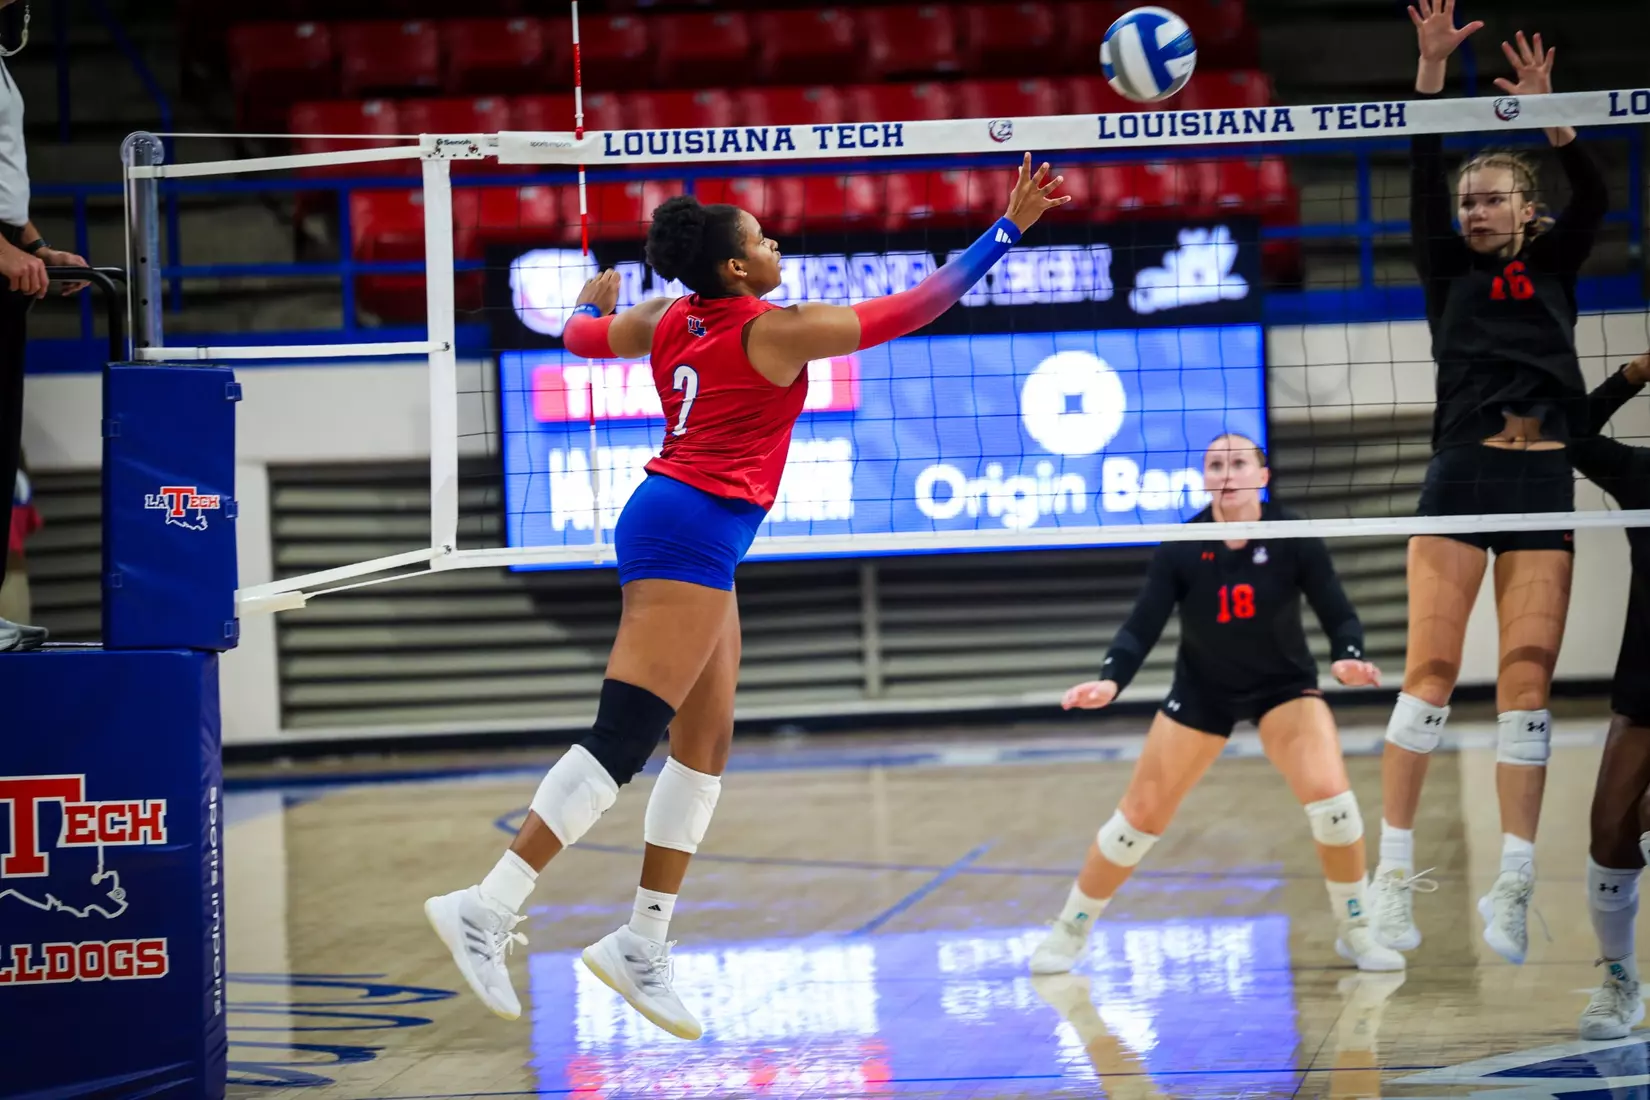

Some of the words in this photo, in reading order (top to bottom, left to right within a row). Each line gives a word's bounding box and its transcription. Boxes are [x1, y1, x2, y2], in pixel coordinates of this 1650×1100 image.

[604, 127, 795, 156] LOUISIANA
[812, 123, 904, 149] TECH
[1098, 108, 1294, 139] LOUISIANA
[1312, 103, 1406, 131] TECH
[1489, 261, 1535, 300] 16
[160, 486, 221, 517] TECH
[915, 461, 1087, 529] Origin
[1102, 456, 1213, 512] Ban
[1216, 584, 1256, 624] 18
[209, 787, 219, 886] sports
[211, 892, 223, 1016] imports
